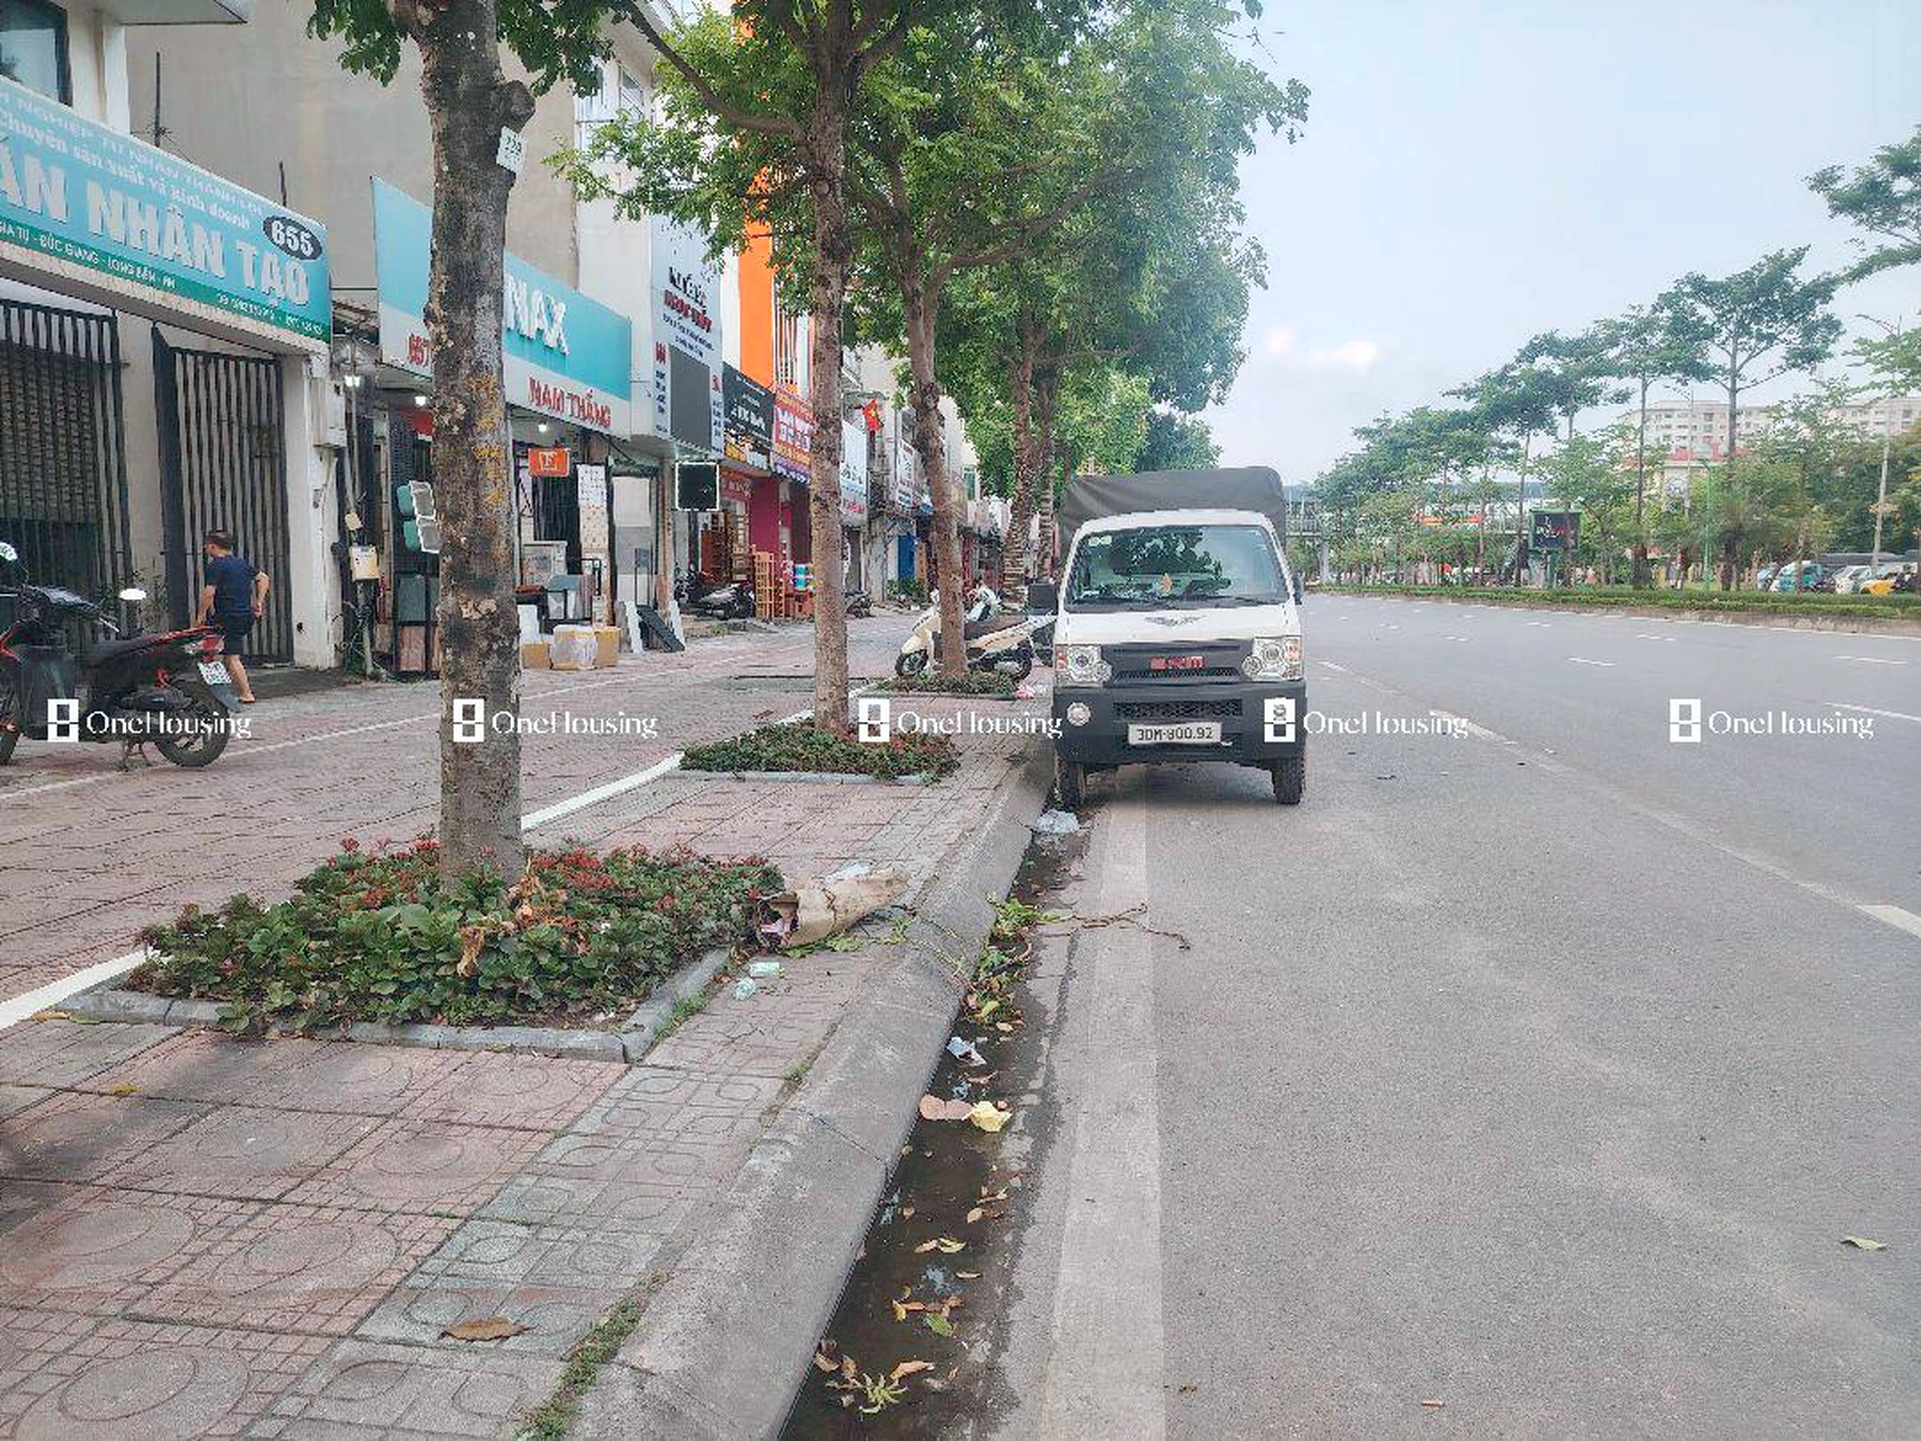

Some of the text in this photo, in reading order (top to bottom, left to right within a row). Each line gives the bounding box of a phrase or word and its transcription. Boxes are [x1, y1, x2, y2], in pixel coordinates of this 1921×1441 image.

[87, 178, 226, 279] NHÂN
[236, 240, 309, 307] TẠO
[271, 219, 314, 258] 655
[503, 272, 569, 355] NAX
